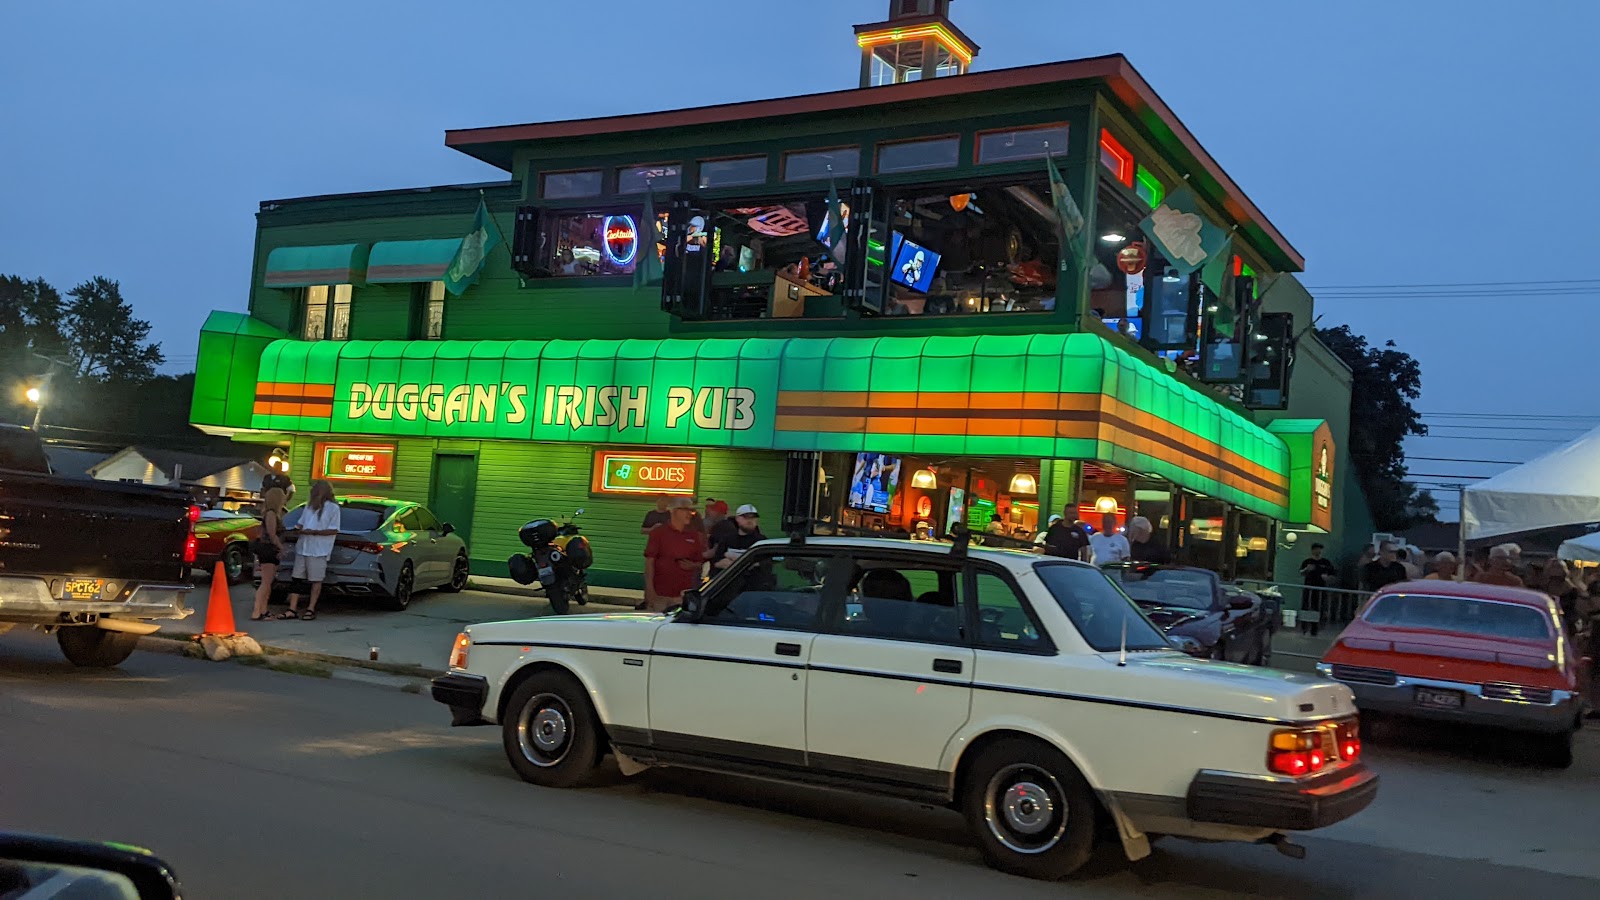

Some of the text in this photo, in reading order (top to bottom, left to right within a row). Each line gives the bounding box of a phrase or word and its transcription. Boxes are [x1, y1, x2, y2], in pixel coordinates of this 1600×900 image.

[348, 382, 756, 432] DUGGAN'S IRISH PUB
[345, 465, 376, 473] BIG CHIEF
[638, 466, 685, 482] OLDIES
[65, 582, 100, 593] 5PCT62
